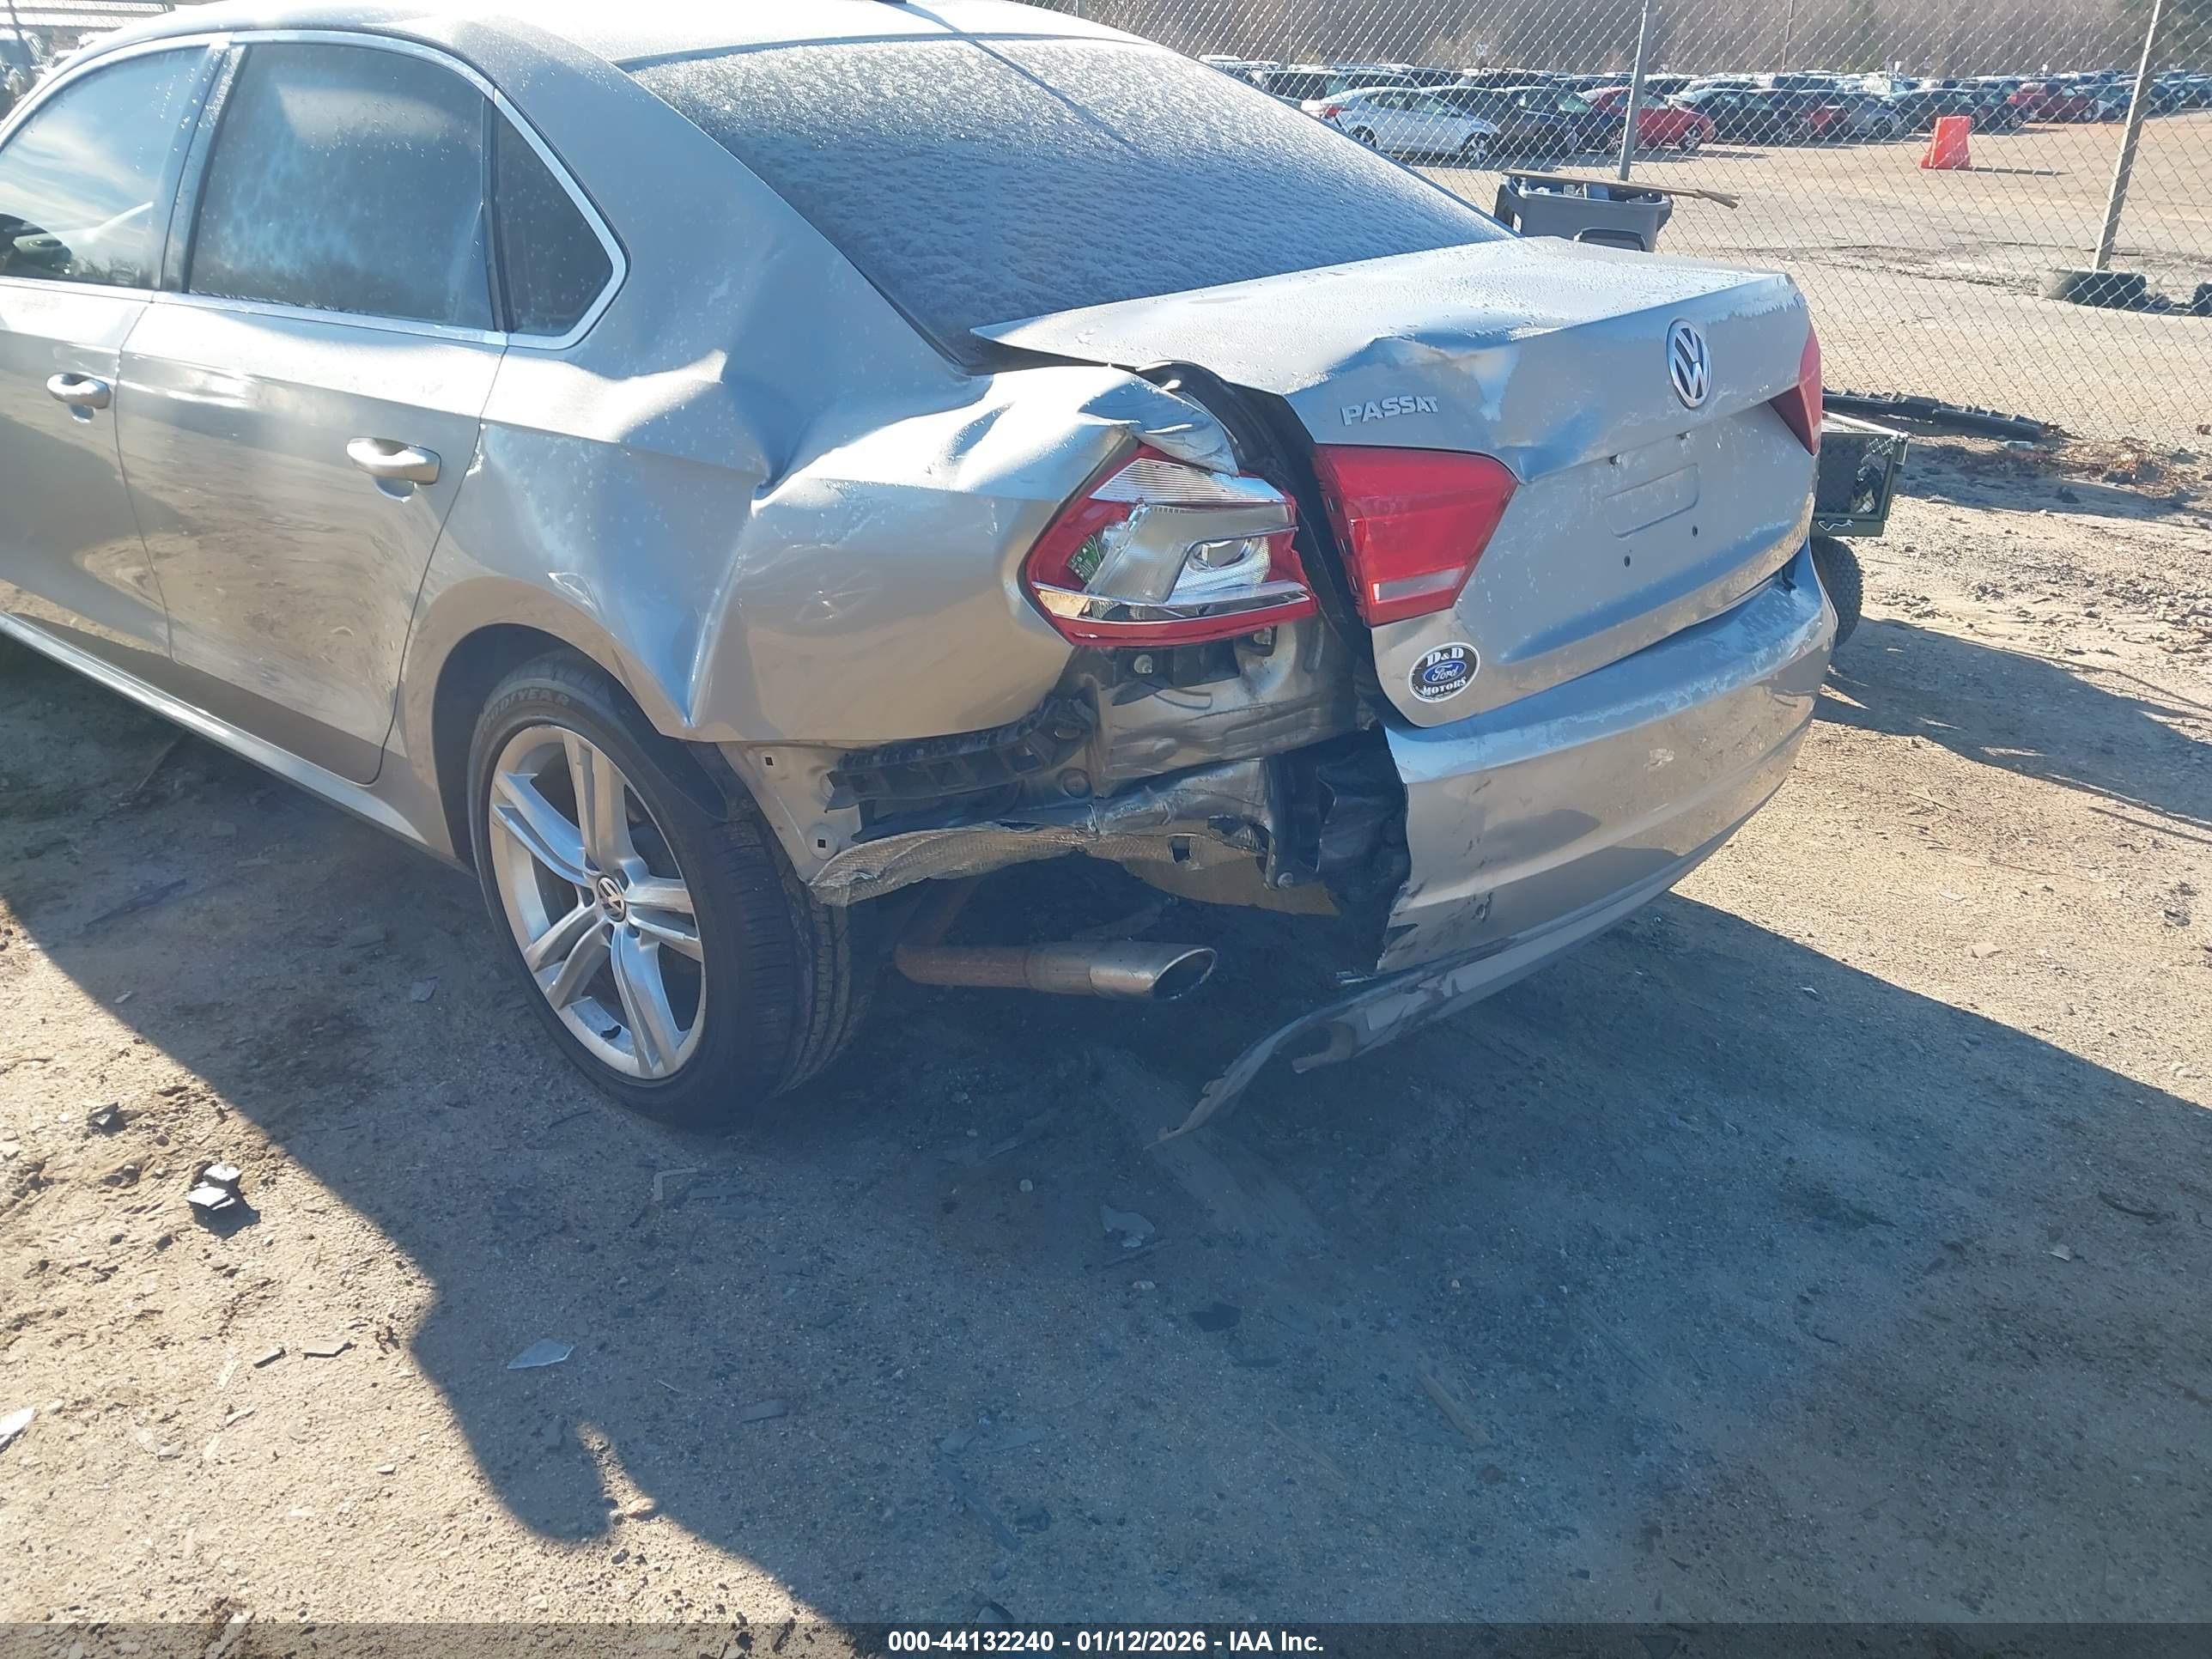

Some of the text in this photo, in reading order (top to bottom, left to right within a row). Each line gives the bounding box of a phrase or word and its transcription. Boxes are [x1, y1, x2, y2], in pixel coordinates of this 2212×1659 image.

[1340, 395, 1439, 426] PASSAT
[1426, 647, 1464, 666] D&D
[1431, 664, 1459, 681] Ford
[1423, 676, 1467, 696] MOTORS
